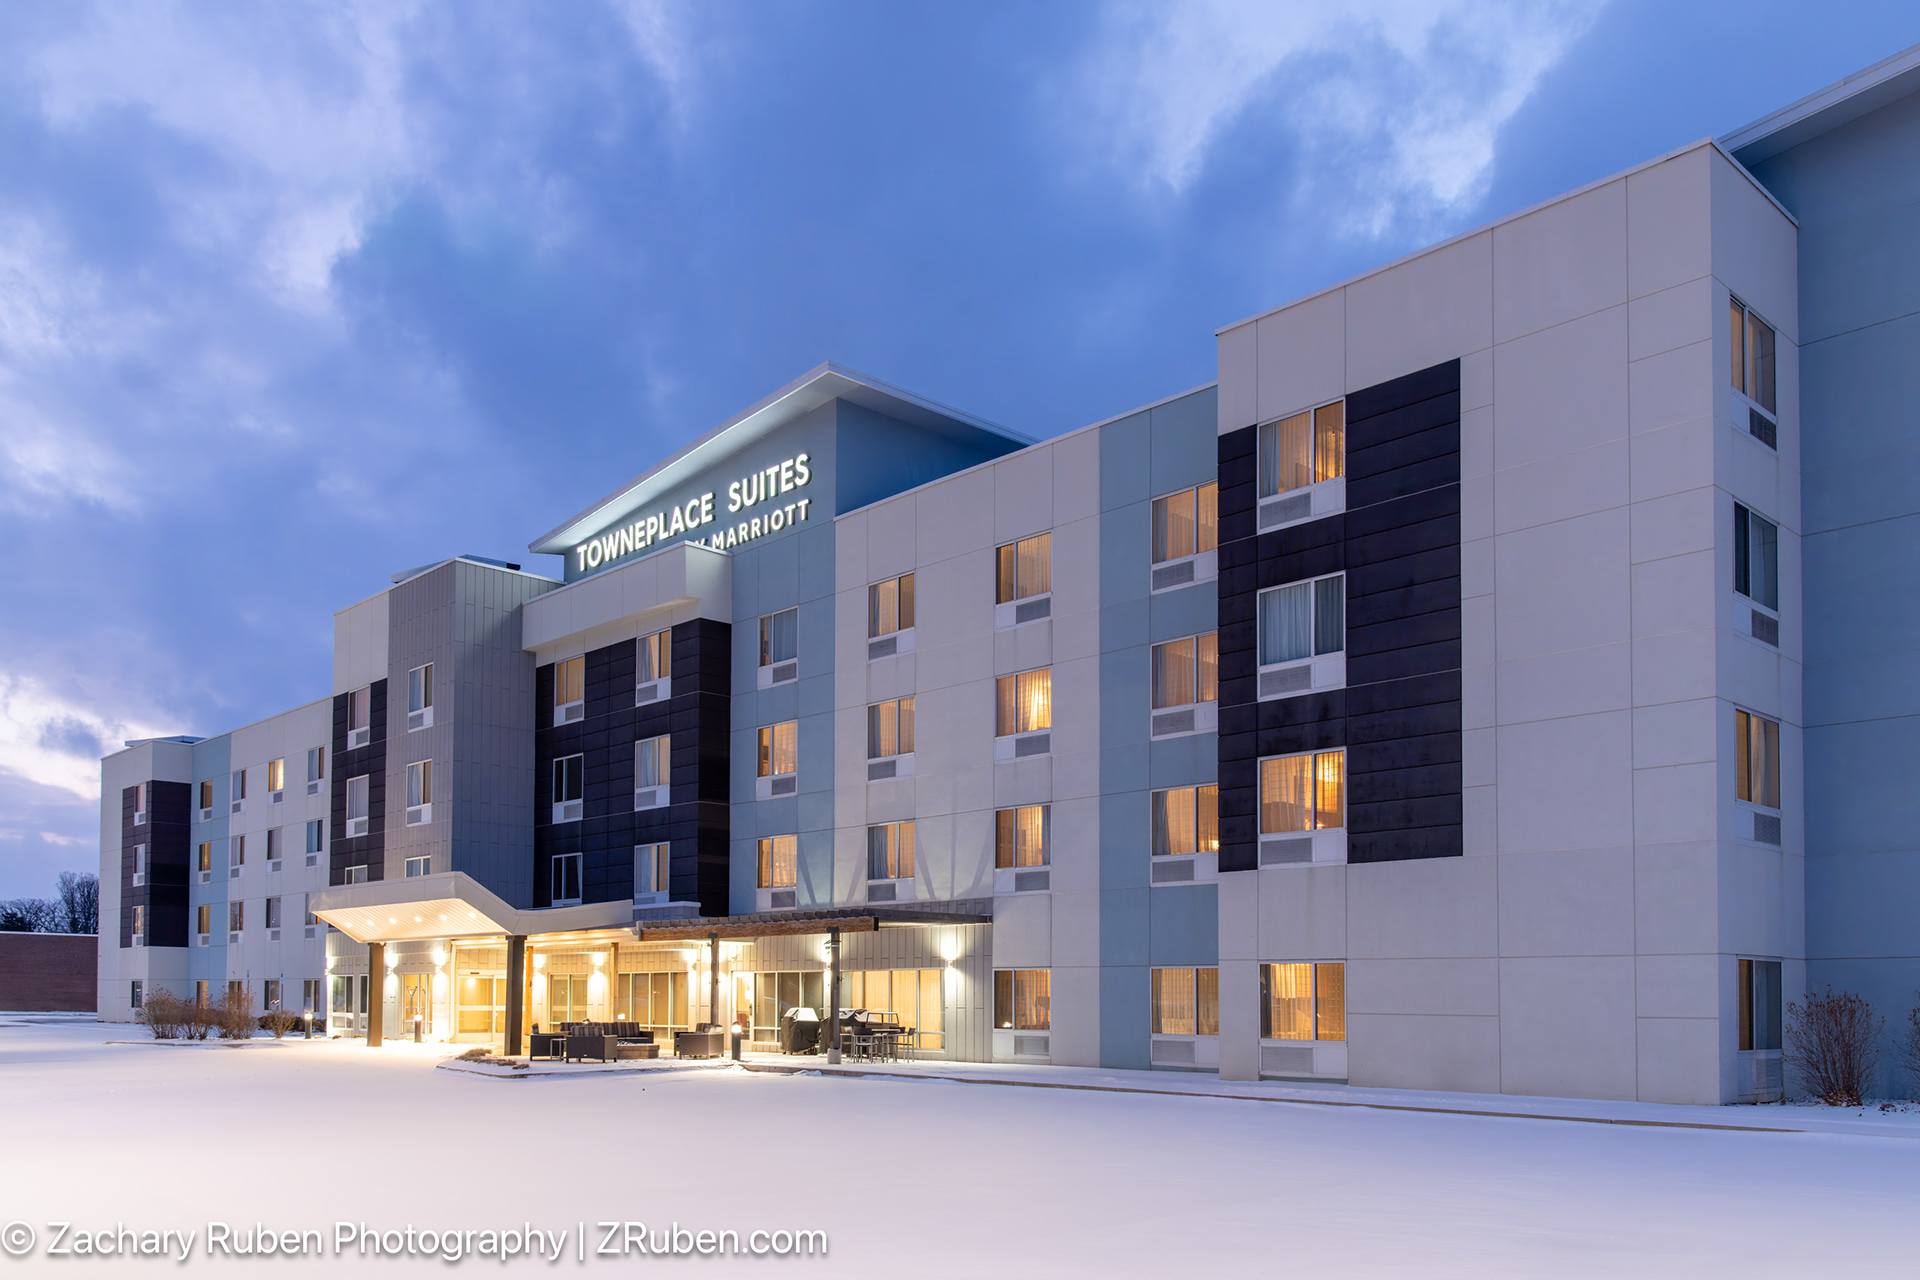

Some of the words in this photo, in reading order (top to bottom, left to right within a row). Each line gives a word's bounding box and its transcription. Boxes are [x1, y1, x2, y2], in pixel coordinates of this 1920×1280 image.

[576, 492, 716, 571] TOWNEPLACE
[728, 453, 812, 512] SUITES
[712, 499, 811, 550] MARRIOTT
